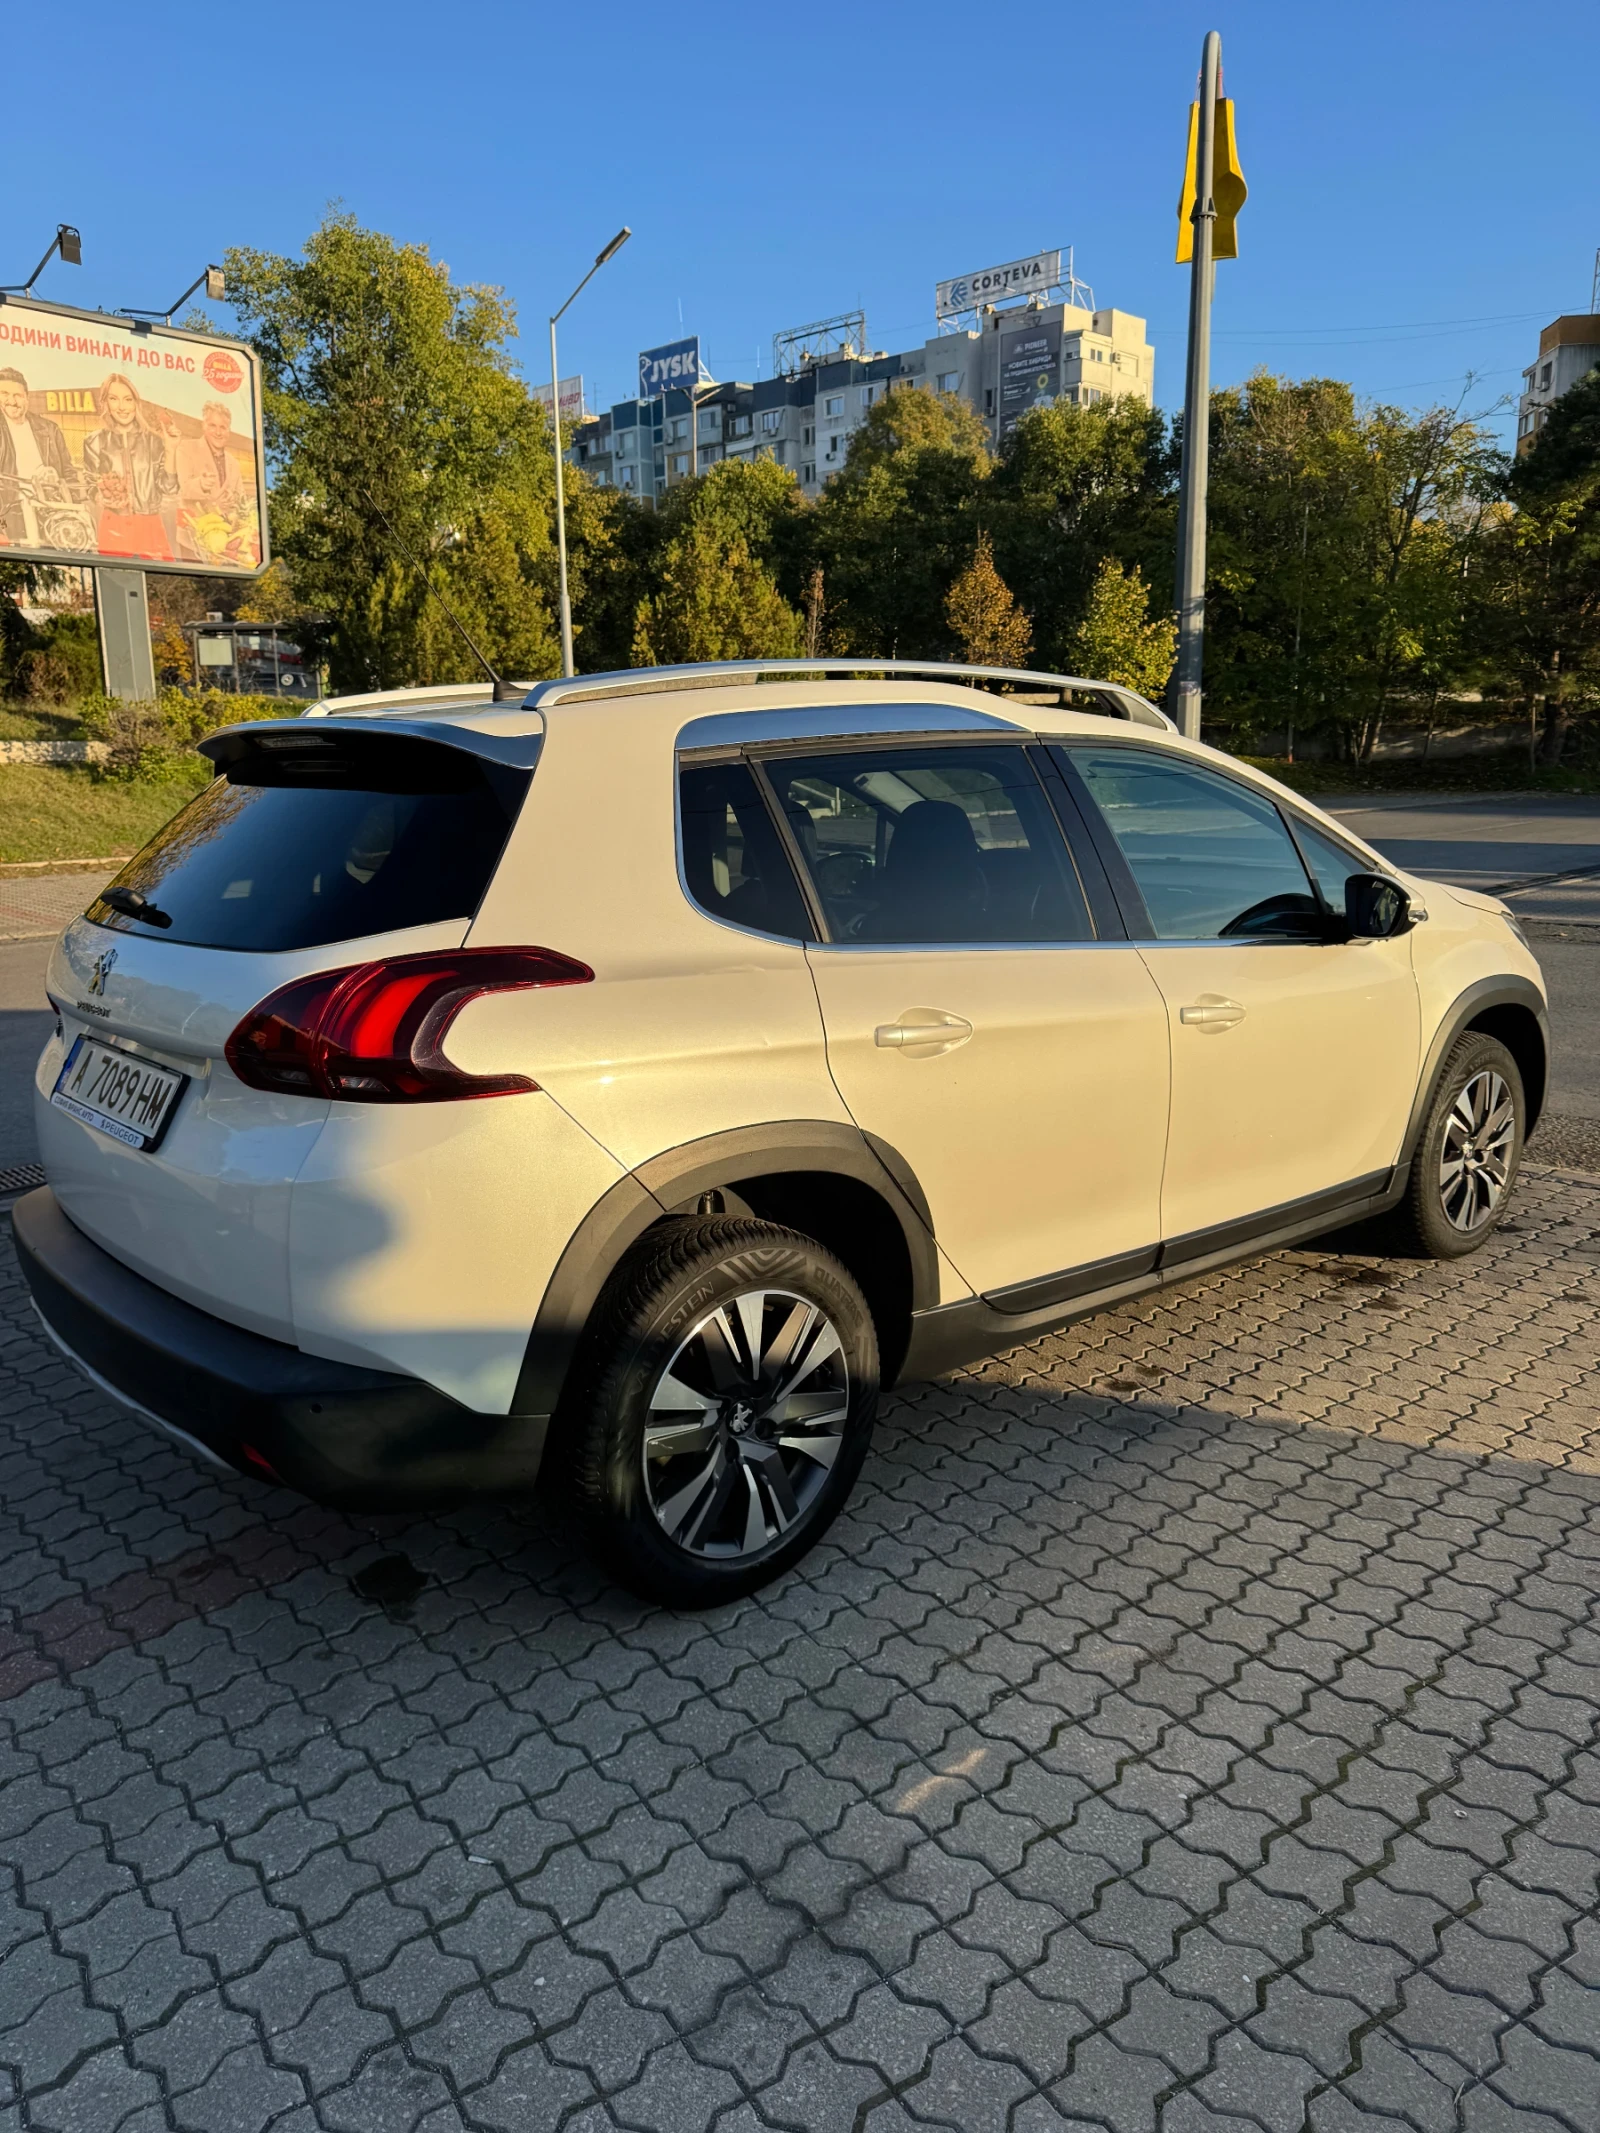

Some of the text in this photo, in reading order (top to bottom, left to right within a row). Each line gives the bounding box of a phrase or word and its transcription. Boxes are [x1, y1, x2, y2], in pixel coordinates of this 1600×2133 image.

[972, 262, 1042, 291] CORTEVA
[0, 322, 61, 350] ОДИНИ
[65, 335, 133, 362] ВИНАГИ
[137, 348, 160, 369] ДО
[164, 353, 195, 373] ВАС
[202, 367, 216, 380] 25
[650, 350, 696, 382] JYSK
[46, 391, 97, 412] BILLA
[71, 1050, 173, 1129] A 7089 HM
[105, 1121, 140, 1145] PEUGEOT
